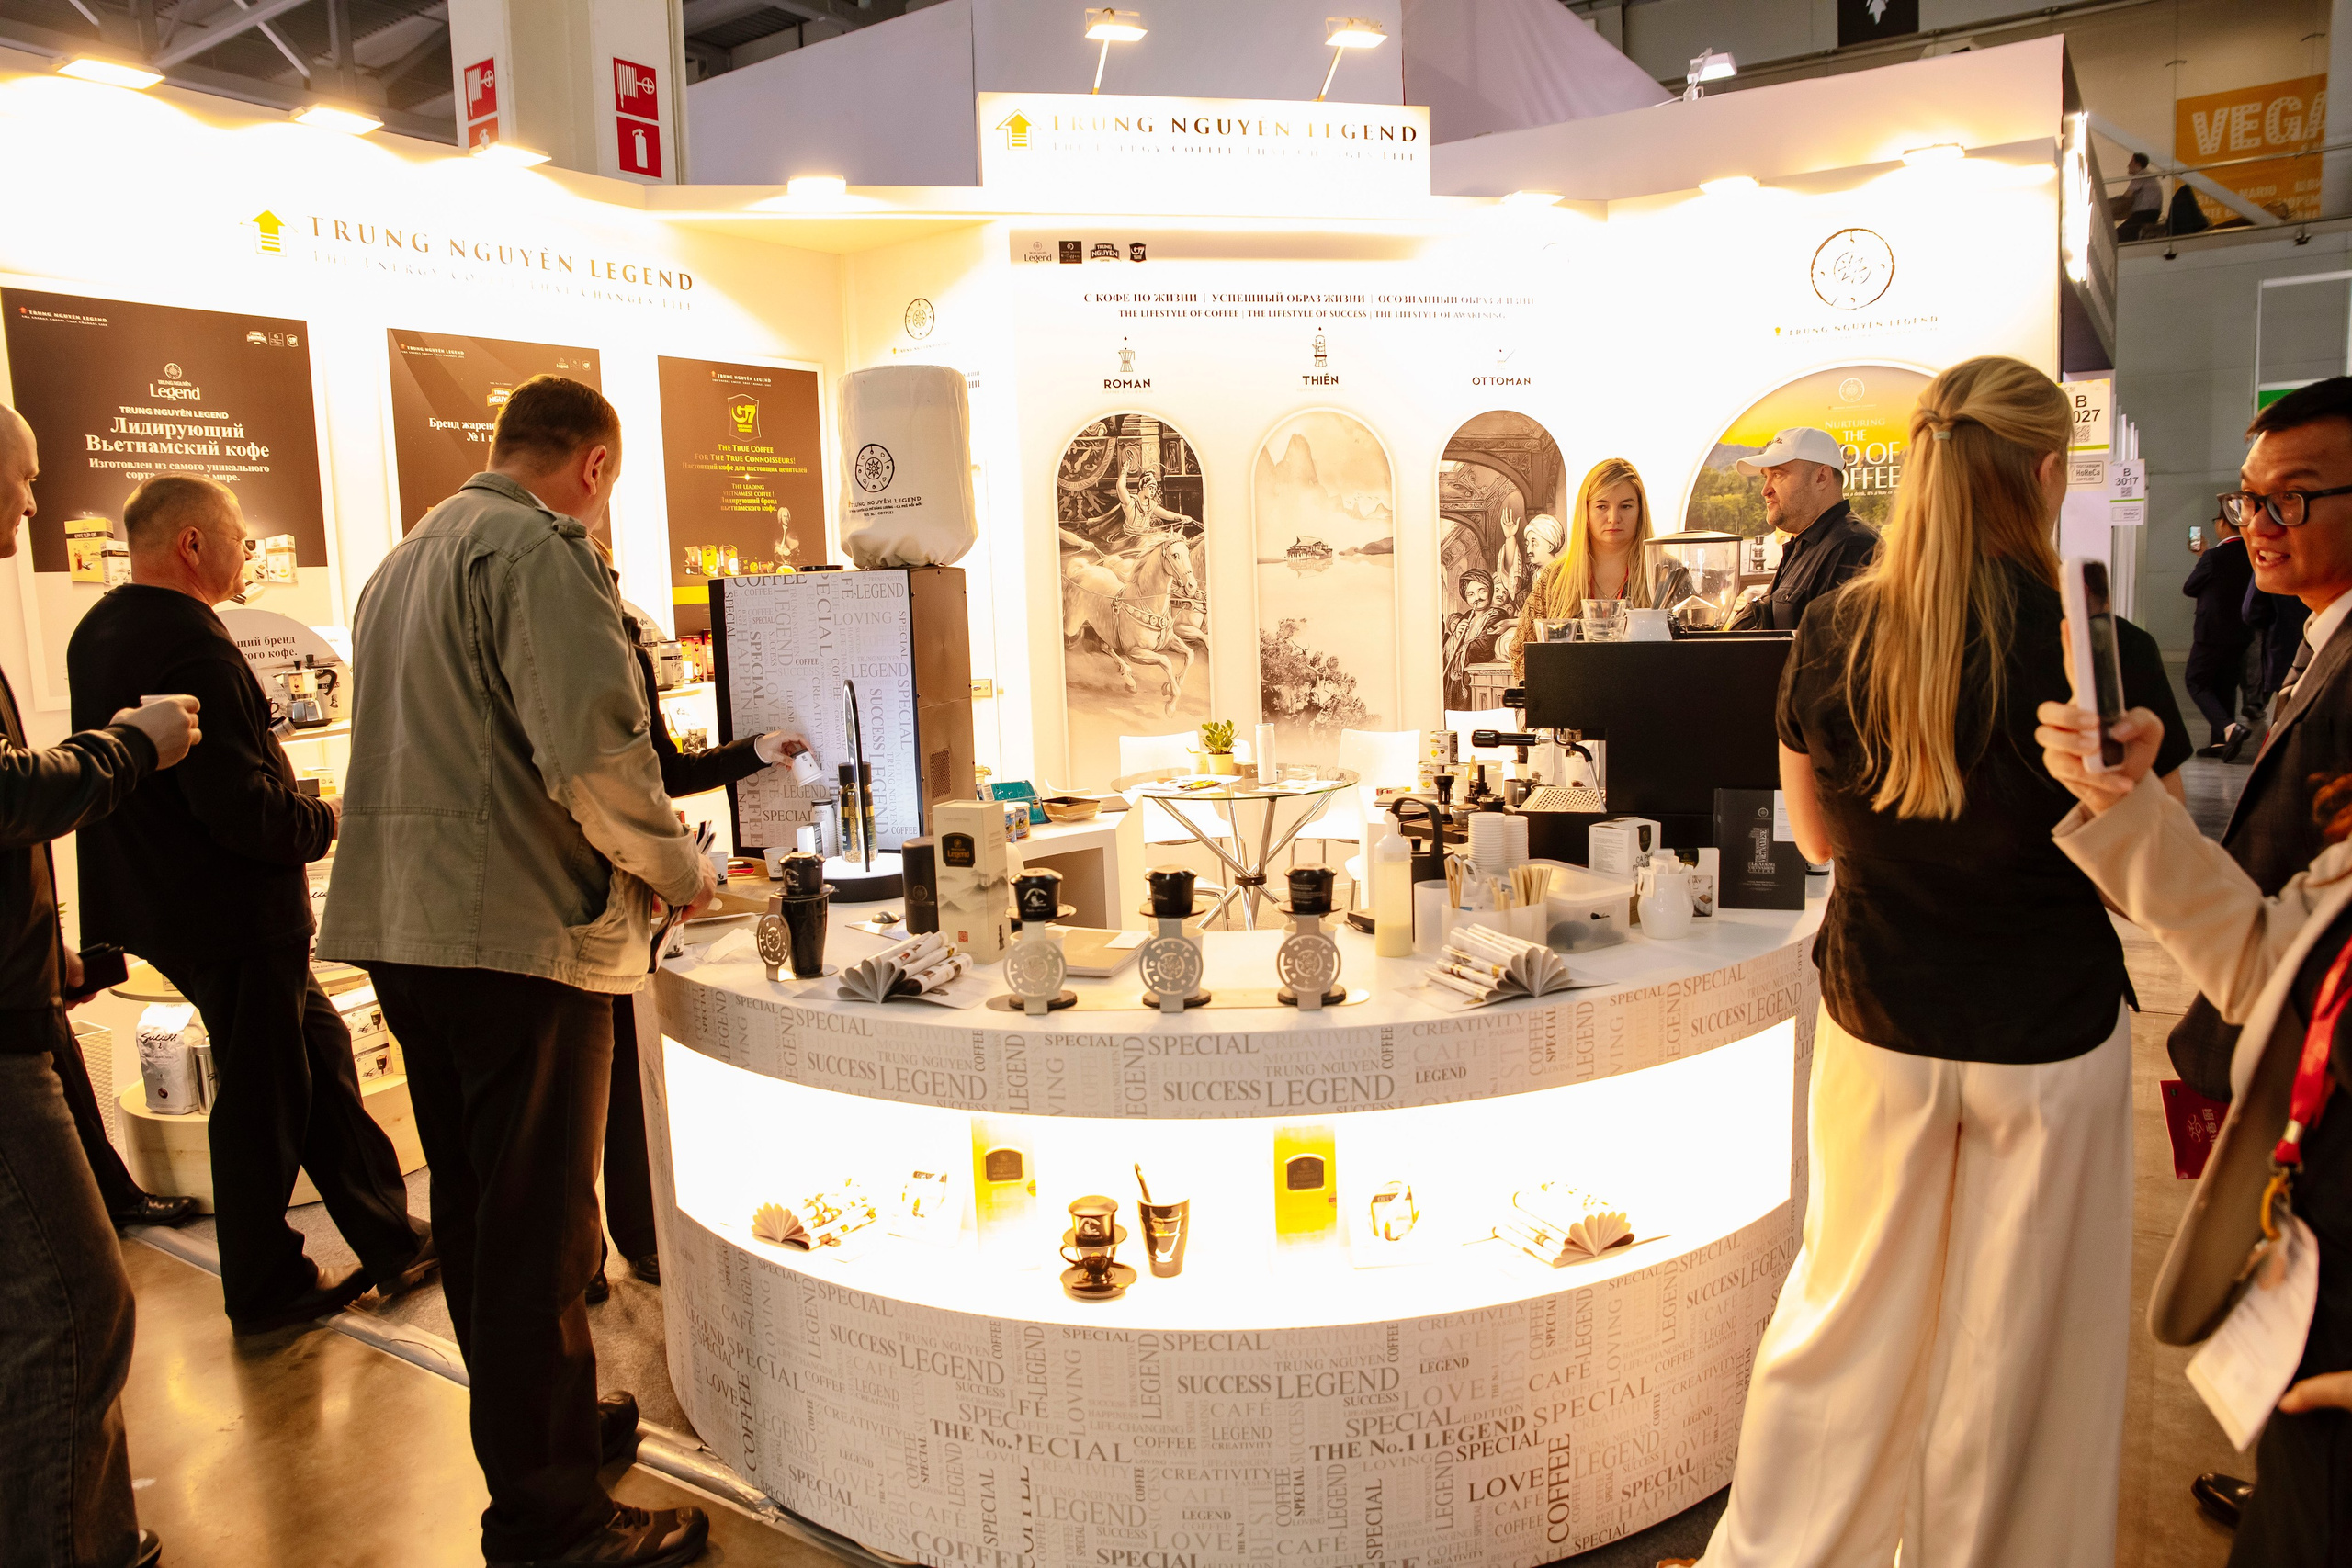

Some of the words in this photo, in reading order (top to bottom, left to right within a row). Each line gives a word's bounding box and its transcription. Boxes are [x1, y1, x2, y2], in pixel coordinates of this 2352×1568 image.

[307, 215, 429, 253] TRUNG
[590, 259, 693, 291] LEGEND
[1024, 254, 1052, 263] Legend
[1096, 293, 1130, 303] КОФЕ
[1154, 293, 1197, 303] ЖИЗНИ
[1212, 291, 1283, 303] УСПЕШНЫЙ
[1286, 294, 1321, 304] ОБРАЗ
[1323, 294, 1365, 304] ЖИЗНИ
[1118, 310, 1137, 318] THE
[1141, 310, 1187, 318] LIFESTYLE
[1190, 310, 1203, 318] OF
[1204, 310, 1239, 318] COFFEE
[1248, 310, 1266, 318] THE
[1269, 310, 1313, 318] LIFESTYLE
[149, 383, 201, 400] Legend
[1103, 378, 1151, 389] ROMAN
[1472, 376, 1532, 386] OTTOMAN
[119, 406, 153, 415] TRUNG
[194, 411, 229, 419] LEGEND
[2076, 395, 2087, 408] B
[429, 417, 460, 432] Бренд
[1825, 418, 1885, 429] NURTURING
[2074, 409, 2101, 423] 027
[110, 417, 244, 440] Лидирующий
[467, 432, 479, 442] №
[481, 433, 485, 442] 1
[1843, 429, 1867, 441] THE
[85, 434, 220, 456] Вьетнамский
[225, 442, 269, 460] кофе
[1866, 442, 1900, 465] OF
[89, 458, 152, 469] Изготовлен
[170, 462, 204, 470] самого
[207, 463, 269, 473] уникального
[1842, 466, 1901, 490] OFFEE
[2116, 477, 2139, 486] 3017
[856, 582, 904, 600] LEGEND
[833, 611, 892, 626] LOVING
[265, 637, 296, 648] бренд
[268, 648, 297, 659] кофе.
[796, 658, 819, 666] COFFEE
[851, 662, 909, 678] LEGEND
[1683, 964, 1746, 997] SPECIAL
[735, 995, 779, 1013] SPECIAL
[1610, 985, 1665, 1007] SPECIAL
[1747, 982, 1802, 1026] LEGEND
[796, 1009, 873, 1037] SPECIAL
[1691, 1003, 1745, 1037] SUCCESS
[1045, 1034, 1120, 1047] SPECIAL
[1148, 1034, 1260, 1056] SPECIAL
[808, 1051, 876, 1081] SUCCESS
[1415, 1066, 1467, 1084] LEGEND
[879, 1065, 987, 1101] LEGEND
[1163, 1080, 1261, 1102] SUCCESS
[1266, 1074, 1395, 1107] LEGEND
[1679, 1234, 1740, 1273] SPECIAL
[818, 1281, 893, 1318] SPECIAL
[1686, 1269, 1739, 1309] SUCCESS
[1418, 1303, 1528, 1332] CREATIVITY
[830, 1323, 897, 1358] SUCCESS
[1063, 1327, 1135, 1343] SPECIAL
[1162, 1333, 1271, 1351] SPECIAL
[727, 1336, 805, 1393] SPECIAL
[900, 1345, 1004, 1385] LEGEND
[1419, 1357, 1469, 1374] LEGEND
[1138, 1334, 1162, 1420] LEGEND
[1177, 1374, 1272, 1394] SUCCESS
[1276, 1367, 1400, 1400] LEGEND
[1343, 1392, 1399, 1408] SUCCESS
[1404, 1378, 1486, 1411] LOVE
[1533, 1375, 1653, 1428] SPECIAL
[1134, 1436, 1196, 1450] COFFEE
[1212, 1426, 1272, 1442] LEGEND
[1456, 1429, 1545, 1462] SPECIAL
[1574, 1430, 1660, 1480] LEGEND
[1161, 1468, 1273, 1481] CREATIVITY
[1469, 1467, 1544, 1503] LOVE
[1621, 1458, 1696, 1503] SPECIAL
[788, 1464, 859, 1509] SPECIAL
[1435, 1450, 1454, 1532] LEGEND
[1547, 1434, 1570, 1544] COFFEE
[1036, 1495, 1147, 1528] LEGEND
[1182, 1509, 1231, 1521] LEGEND
[1365, 1478, 1383, 1560] SPECIAL
[1574, 1522, 1630, 1552] SPECIAL
